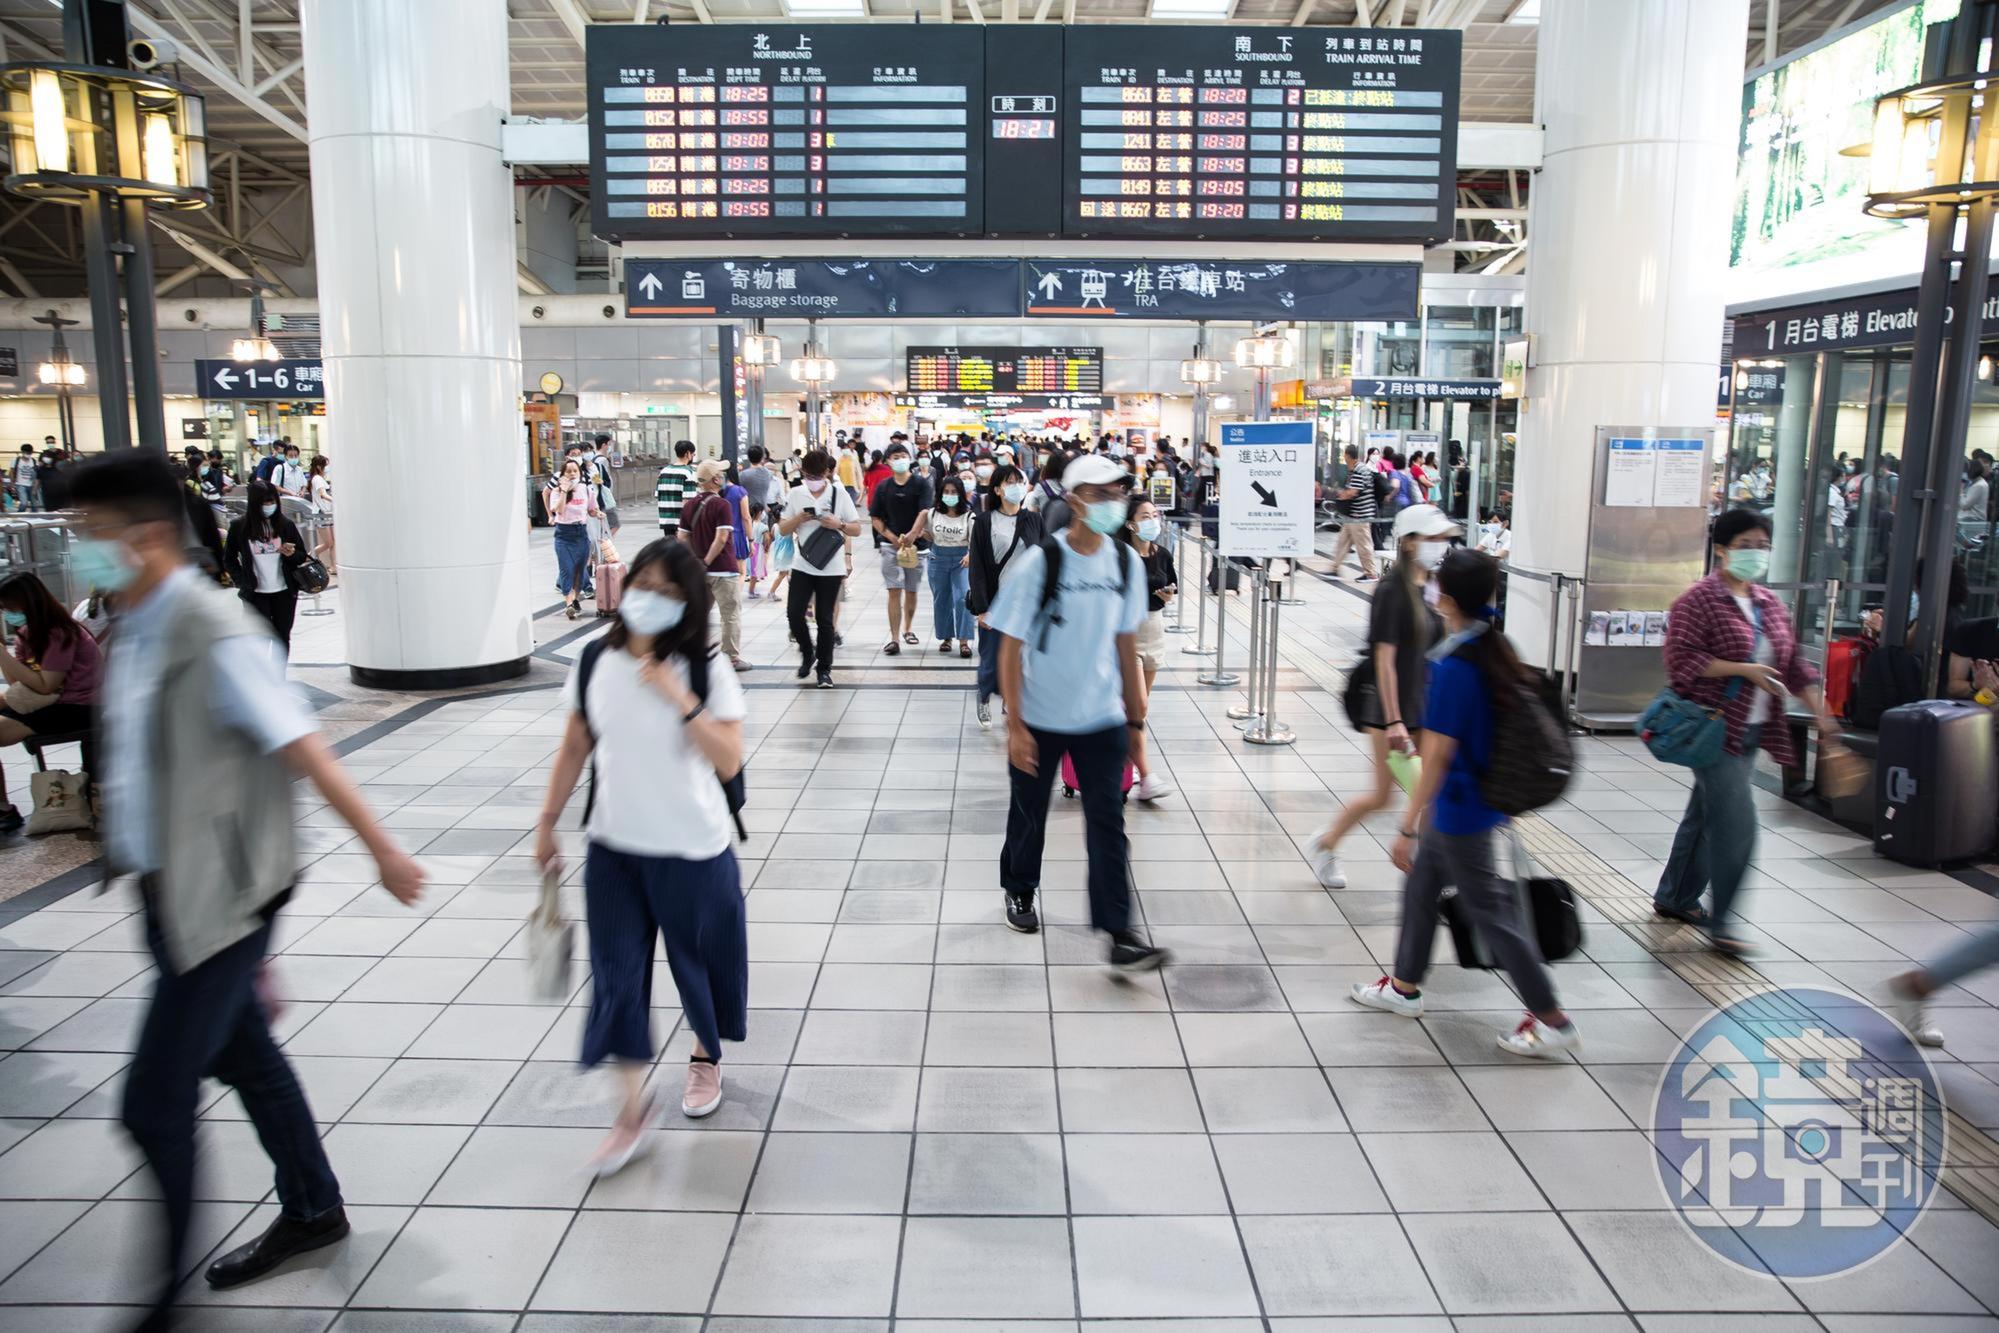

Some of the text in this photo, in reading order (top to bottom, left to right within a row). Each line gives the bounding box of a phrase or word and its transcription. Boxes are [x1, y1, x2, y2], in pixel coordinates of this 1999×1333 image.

[1325, 37, 1423, 52] 列車到站時間
[753, 51, 812, 60] NORTHBOUND
[1235, 52, 1293, 62] SOUTHBOUND
[1325, 53, 1422, 65] TRAIN ARRIVAL TIME
[1226, 77, 1242, 85] TIME
[725, 87, 768, 102] 18:25
[1204, 88, 1247, 104] 18:20
[1287, 89, 1300, 105] 2
[726, 109, 769, 125] 18:55
[1203, 111, 1246, 127] 18:25
[1001, 120, 1055, 138] 18:21
[726, 132, 769, 148] 19:00
[811, 132, 822, 148] 3
[1203, 134, 1246, 150] 18:30
[1286, 135, 1299, 151] 3
[727, 155, 769, 171] 19:15
[811, 155, 822, 171] 3
[1203, 157, 1245, 173] 18:45
[1286, 158, 1298, 174] 3
[727, 179, 769, 194] 19:25
[1202, 180, 1244, 196] 19:05
[727, 201, 770, 217] 19:55
[1202, 203, 1244, 218] 19:20
[1285, 204, 1297, 220] 3
[730, 268, 797, 290] 寄物櫃
[731, 293, 839, 308] Baggage storage
[1134, 294, 1159, 307] TRA
[1765, 320, 1776, 350] 1
[1784, 311, 1860, 346] 月台電梯
[296, 382, 314, 392] Car
[1374, 381, 1385, 395] 2
[1390, 382, 1439, 395] 月台電梯
[1441, 385, 1479, 395] Elevator
[1480, 386, 1491, 395] to
[1747, 389, 1765, 399] Car
[1238, 448, 1297, 464] 進站入口
[1249, 469, 1282, 477] Entrance
